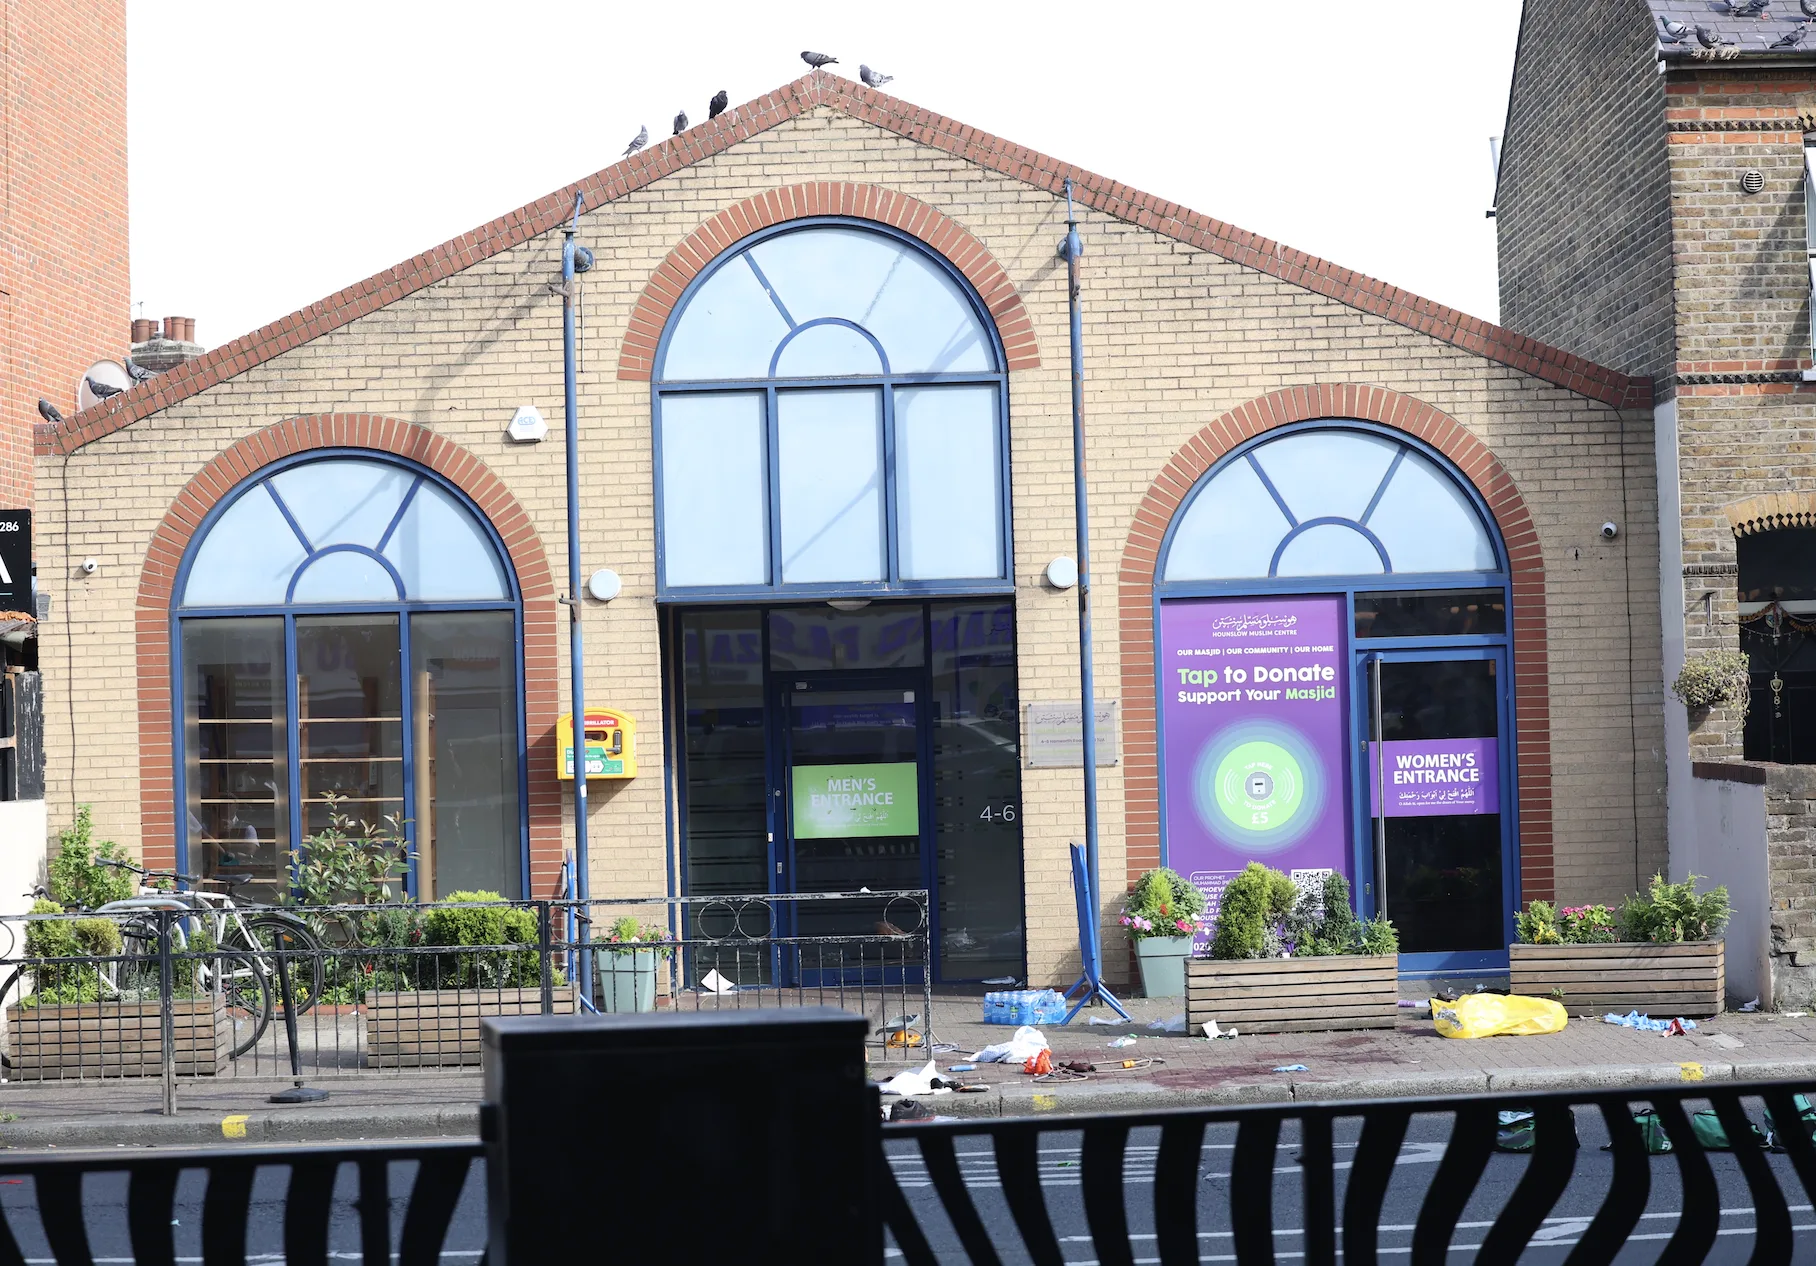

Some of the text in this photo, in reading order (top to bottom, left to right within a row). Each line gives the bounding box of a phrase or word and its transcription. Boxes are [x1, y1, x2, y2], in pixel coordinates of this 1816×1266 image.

[1195, 648, 1221, 656] MASJID
[1227, 647, 1243, 655] OUR
[1244, 646, 1289, 654] COMMUNITY
[1294, 645, 1310, 653] OUR
[1177, 664, 1335, 688] Tap to Donate
[1178, 686, 1336, 705] Support Your Masjid
[1396, 753, 1476, 769] WOMEN'S
[1393, 768, 1480, 784] ENTRANCE
[828, 778, 876, 792] MEN'S
[811, 792, 894, 807] ENTRANCE
[980, 804, 1016, 822] 4-6
[1251, 811, 1269, 825] £5
